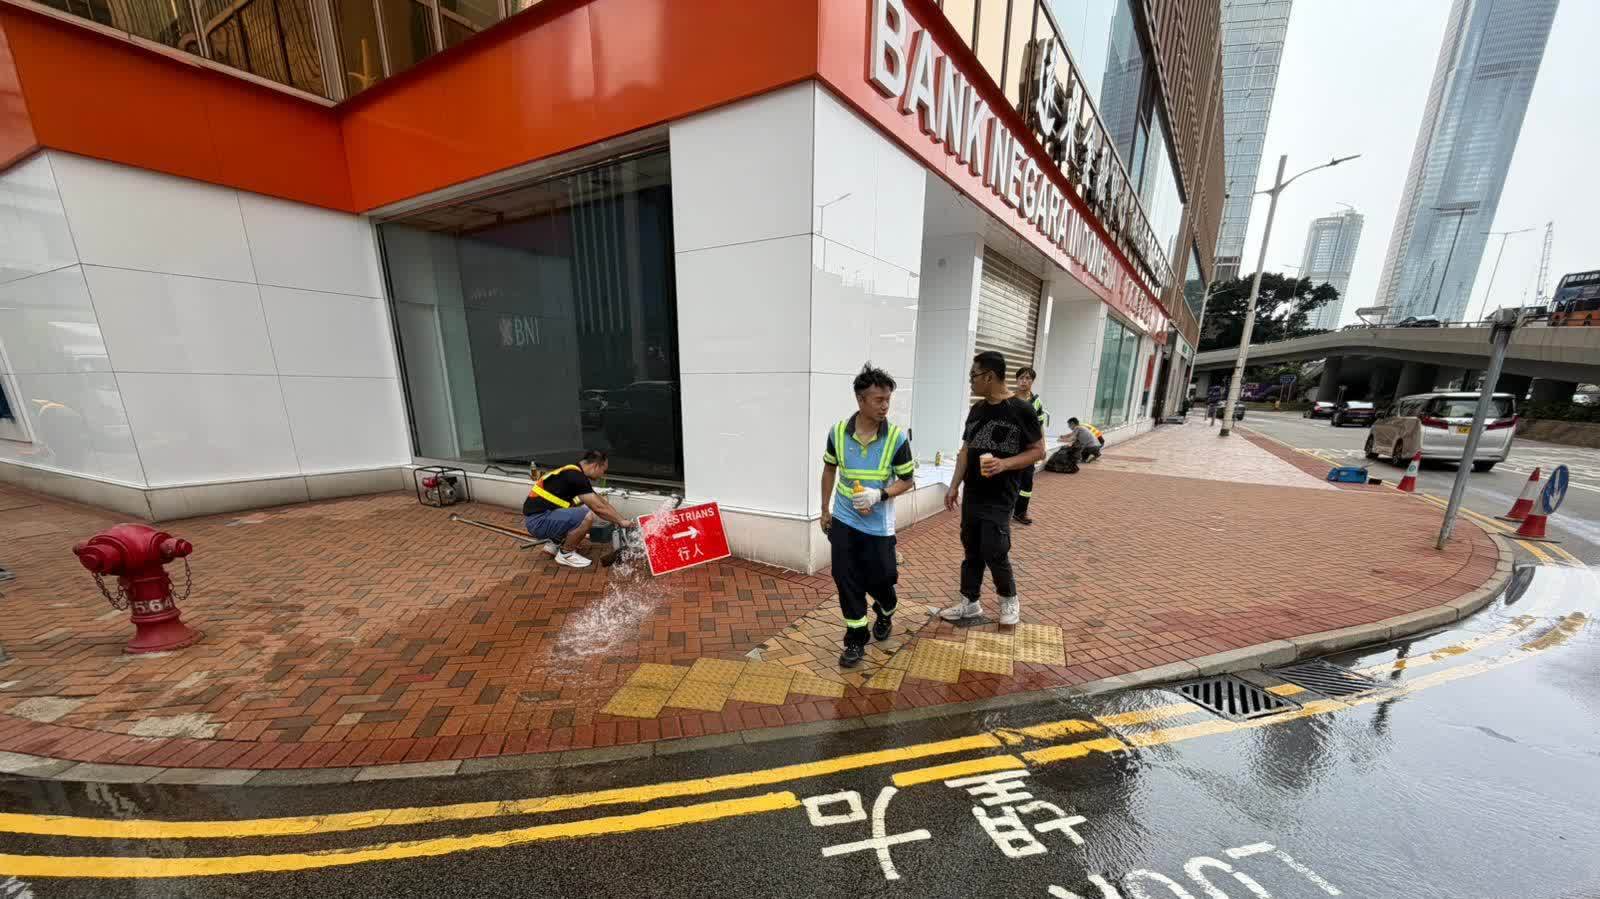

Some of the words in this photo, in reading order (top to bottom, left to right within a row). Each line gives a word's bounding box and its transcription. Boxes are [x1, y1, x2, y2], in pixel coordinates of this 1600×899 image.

[871, 0, 990, 175] BANK
[991, 117, 1073, 250] NEGARA
[514, 316, 541, 346] BNI
[677, 544, 704, 561] 行人
